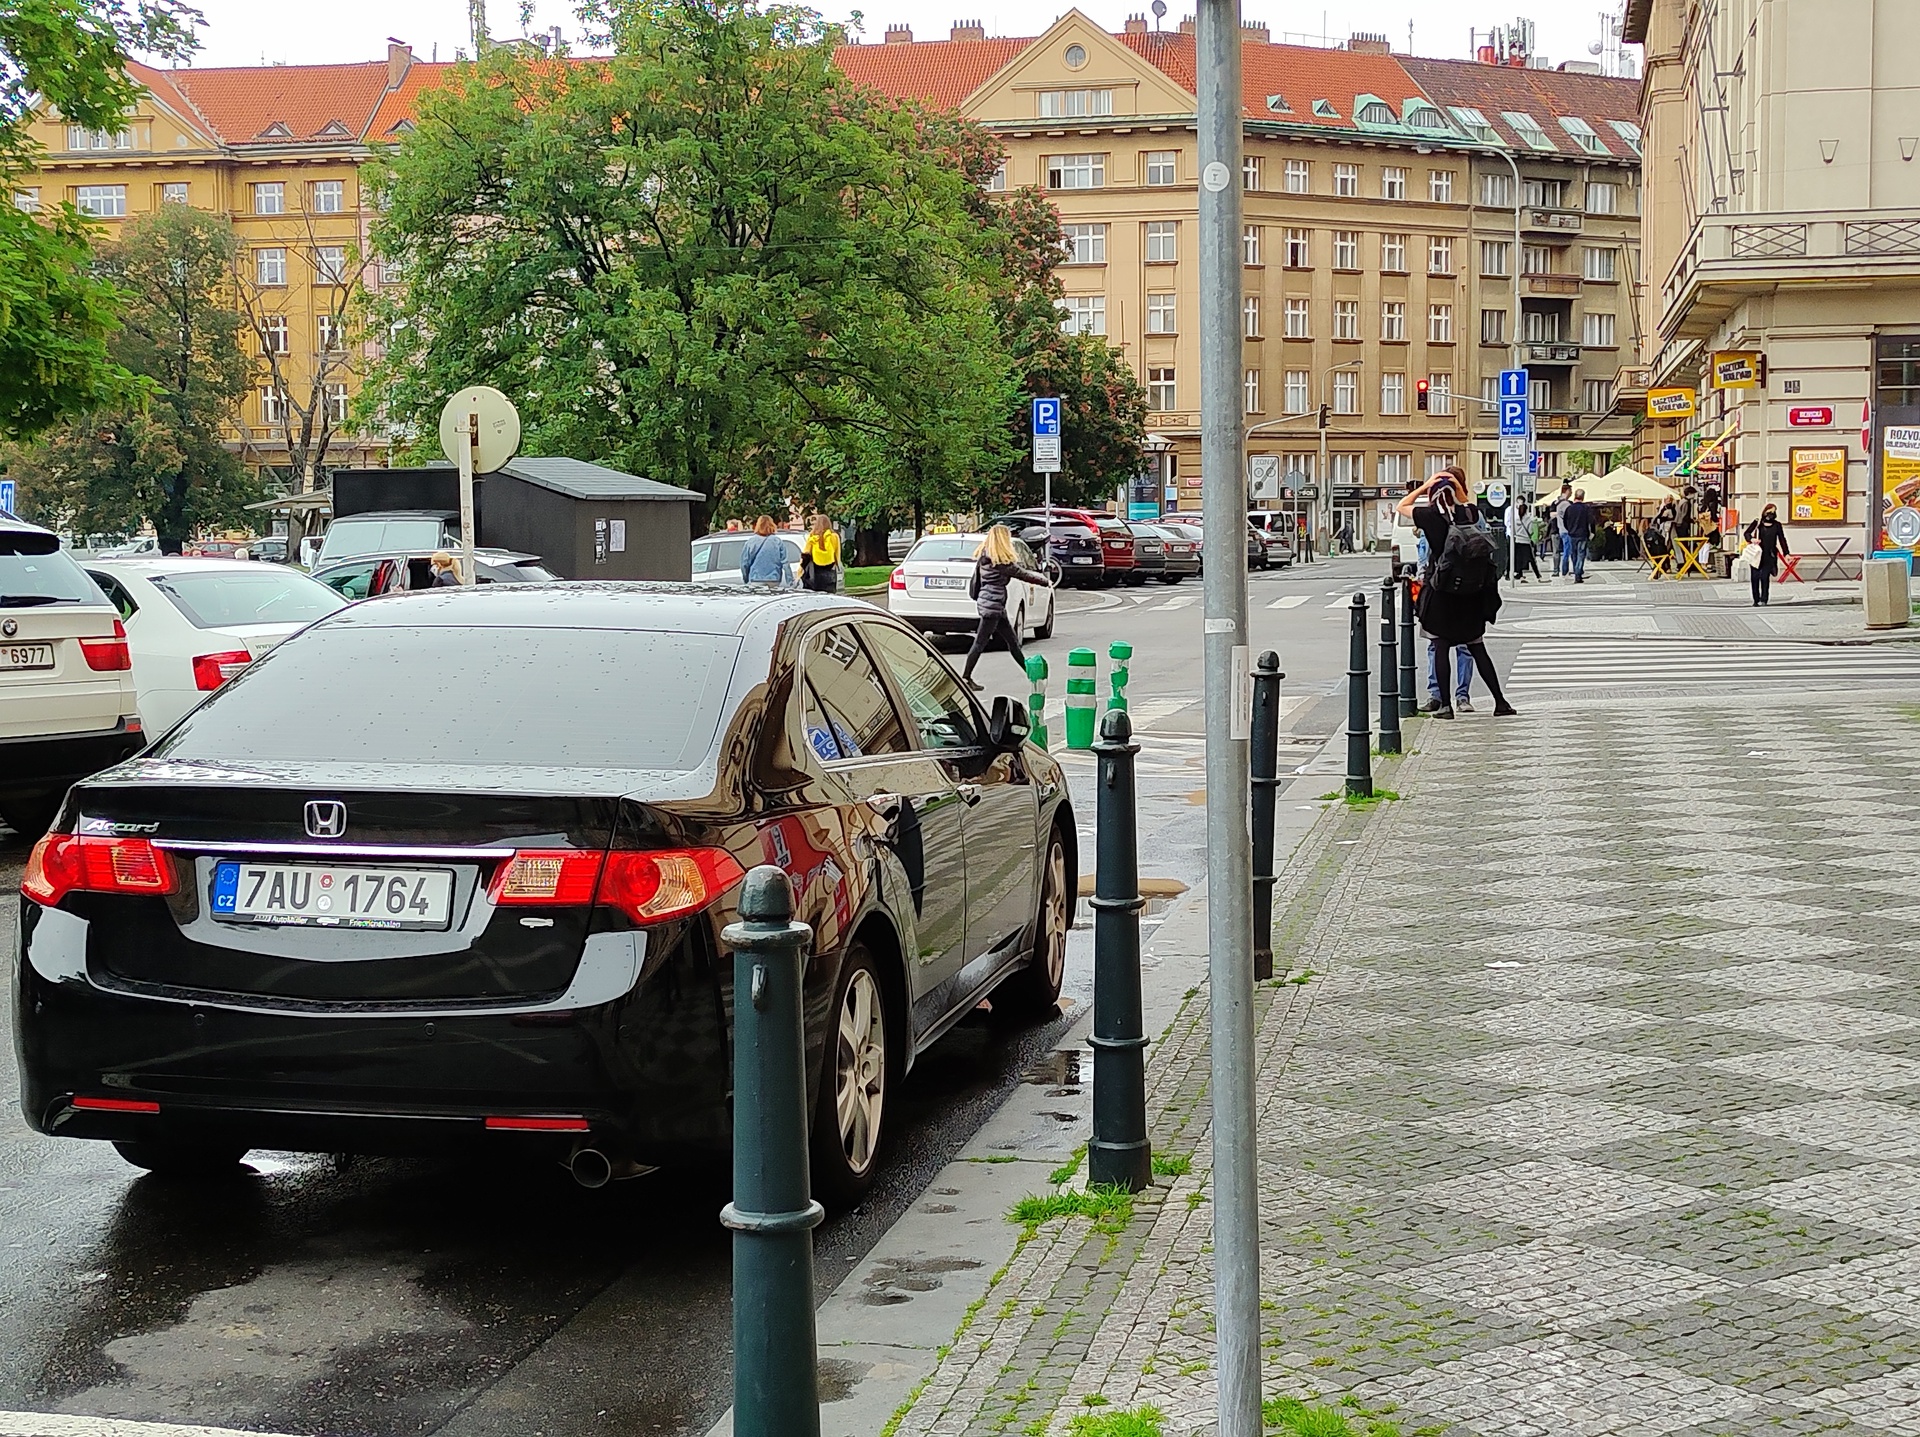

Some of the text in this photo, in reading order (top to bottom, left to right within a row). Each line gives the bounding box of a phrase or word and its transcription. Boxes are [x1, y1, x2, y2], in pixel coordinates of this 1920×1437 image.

[1039, 403, 1054, 425] P
[1506, 403, 1521, 425] P
[1890, 429, 1920, 441] ROZVO
[10, 647, 45, 664] 6977
[83, 820, 160, 833] Accord
[217, 895, 235, 907] CZ
[244, 870, 429, 916] 7AU 1764
